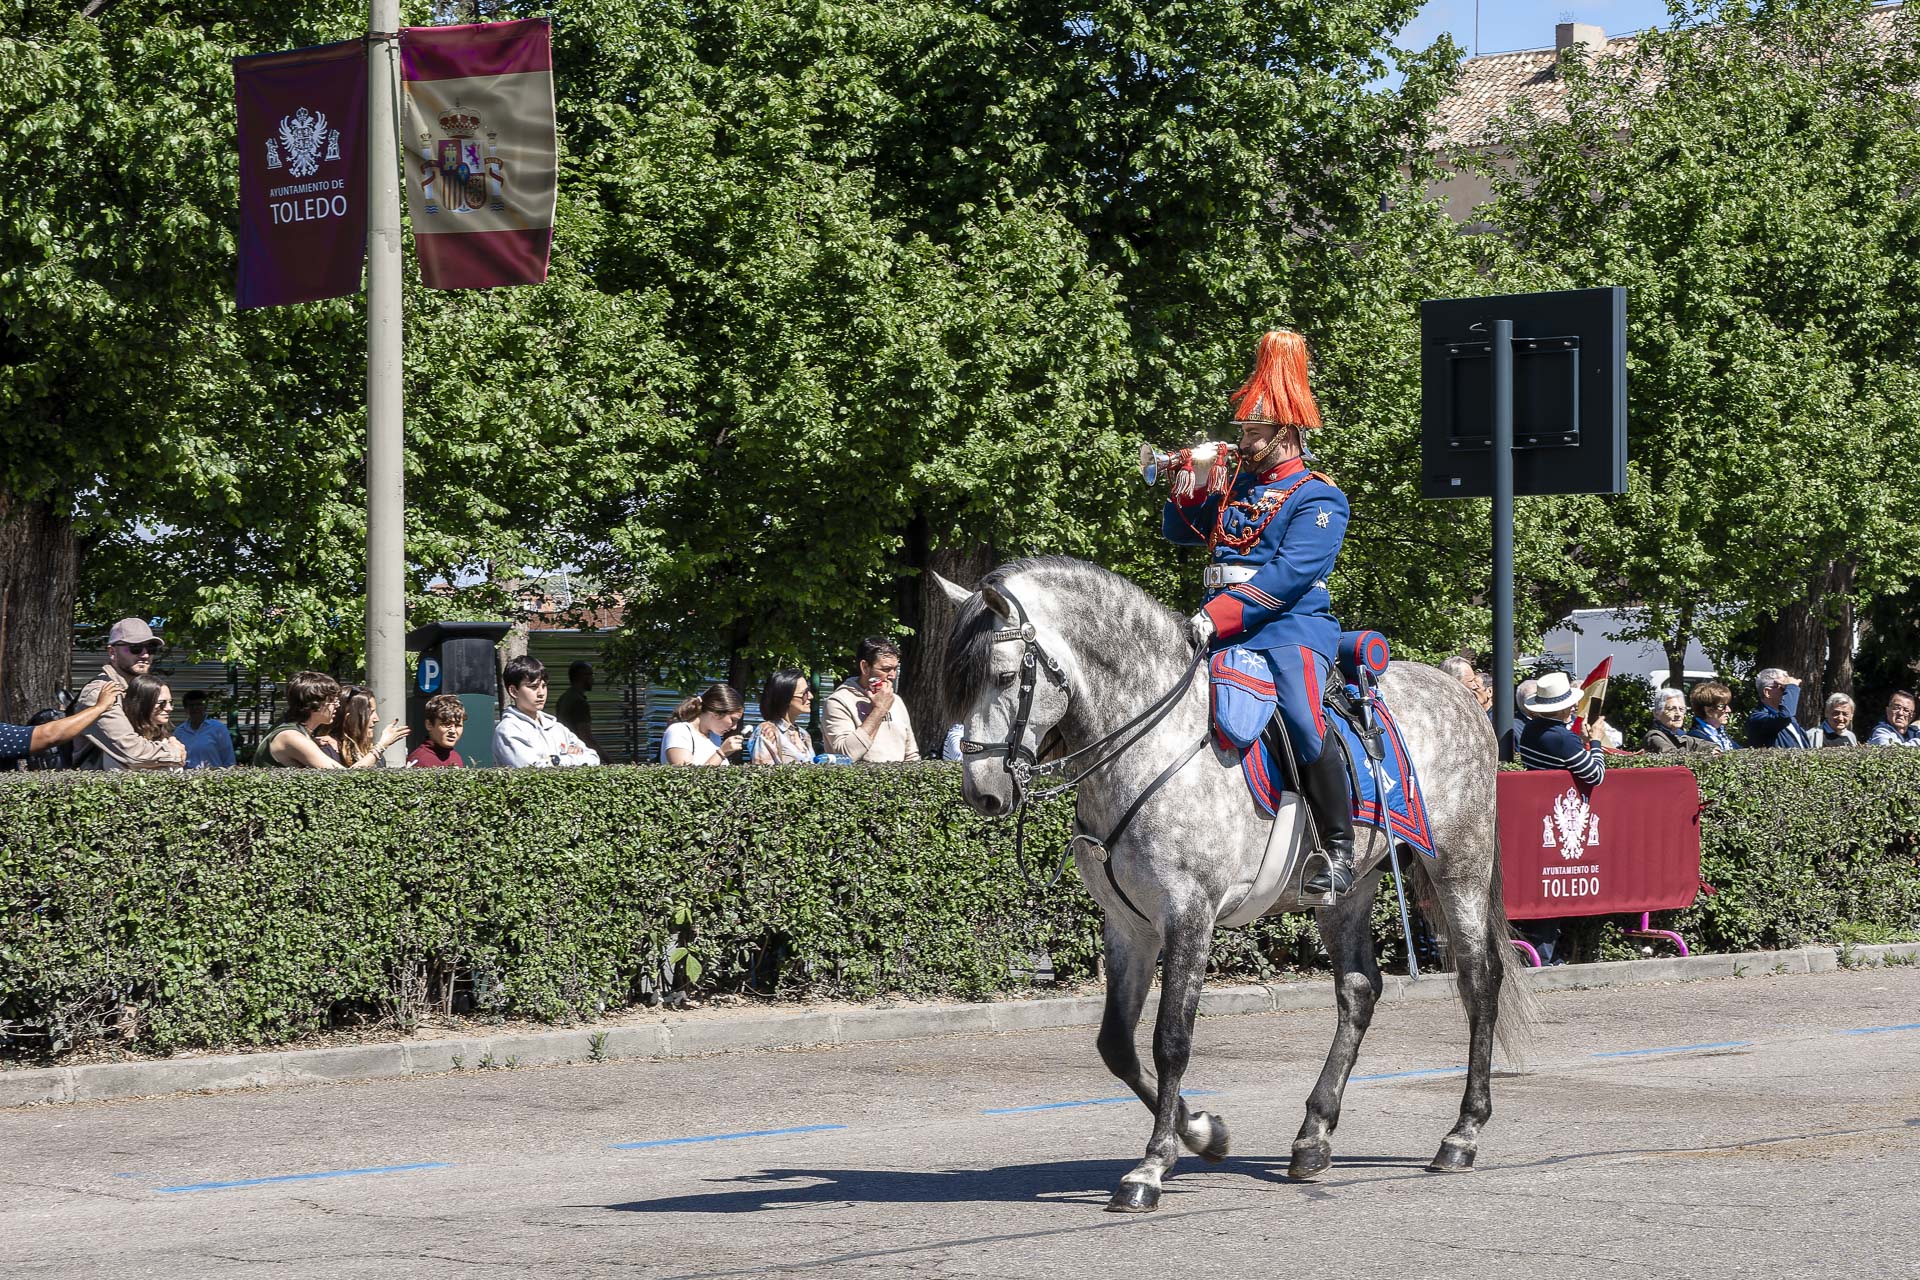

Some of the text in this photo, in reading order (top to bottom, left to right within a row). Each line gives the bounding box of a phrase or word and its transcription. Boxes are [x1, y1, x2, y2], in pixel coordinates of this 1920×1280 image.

[270, 179, 344, 197] AYUNTAMIENTO DE
[270, 195, 347, 224] TOLEDO
[425, 659, 439, 690] P
[1542, 865, 1599, 875] AYUNTAMIENTO DE
[1542, 877, 1600, 897] TOLEDO
